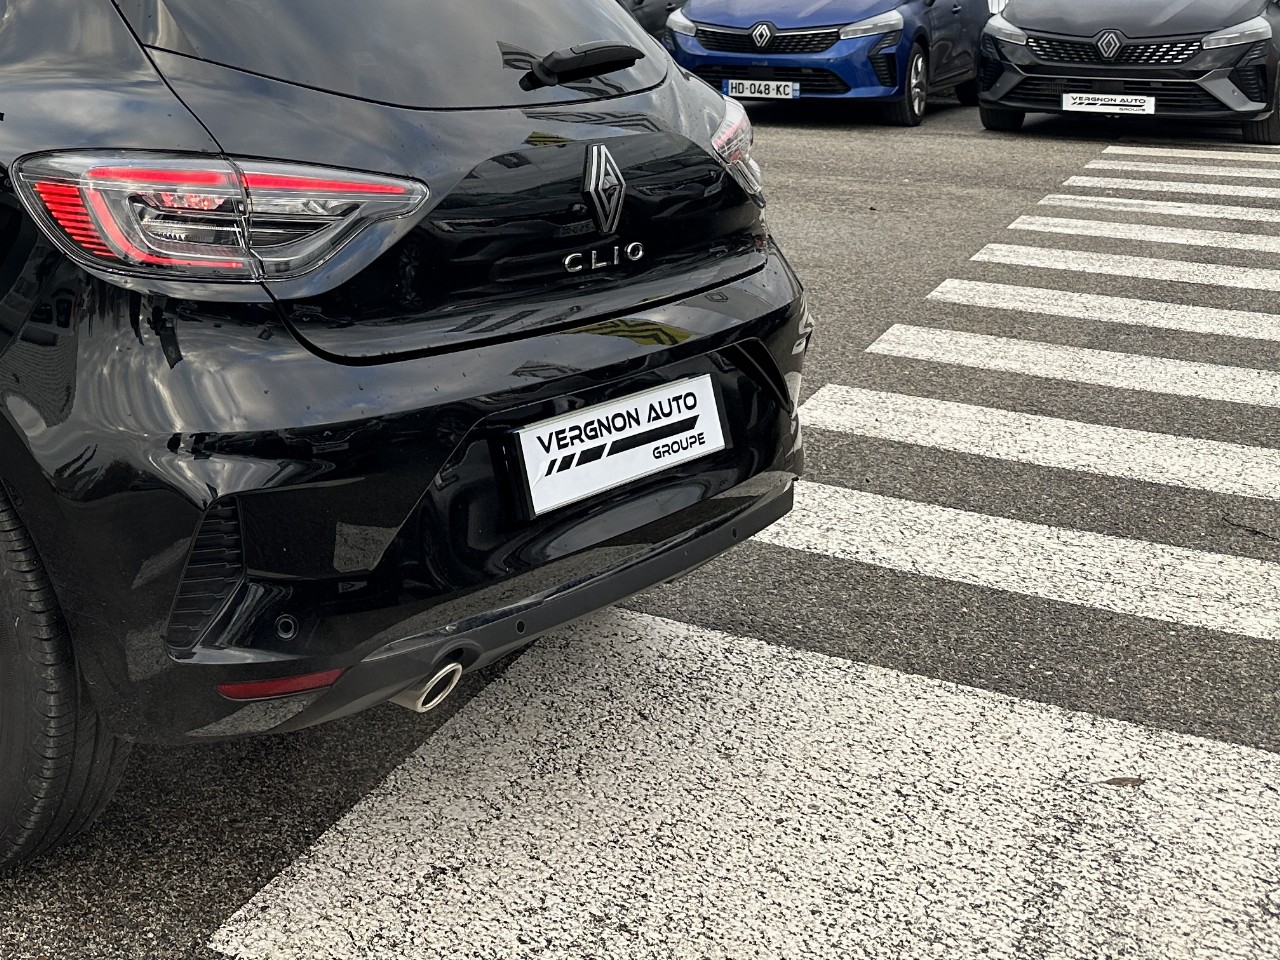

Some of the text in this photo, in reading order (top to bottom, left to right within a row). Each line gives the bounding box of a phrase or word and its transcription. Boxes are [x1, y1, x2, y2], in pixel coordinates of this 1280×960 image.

[730, 82, 790, 96] HD-048-KC
[564, 242, 645, 273] CLIO
[536, 391, 698, 454] VERGNON AUTO
[652, 432, 706, 460] GROUPE
